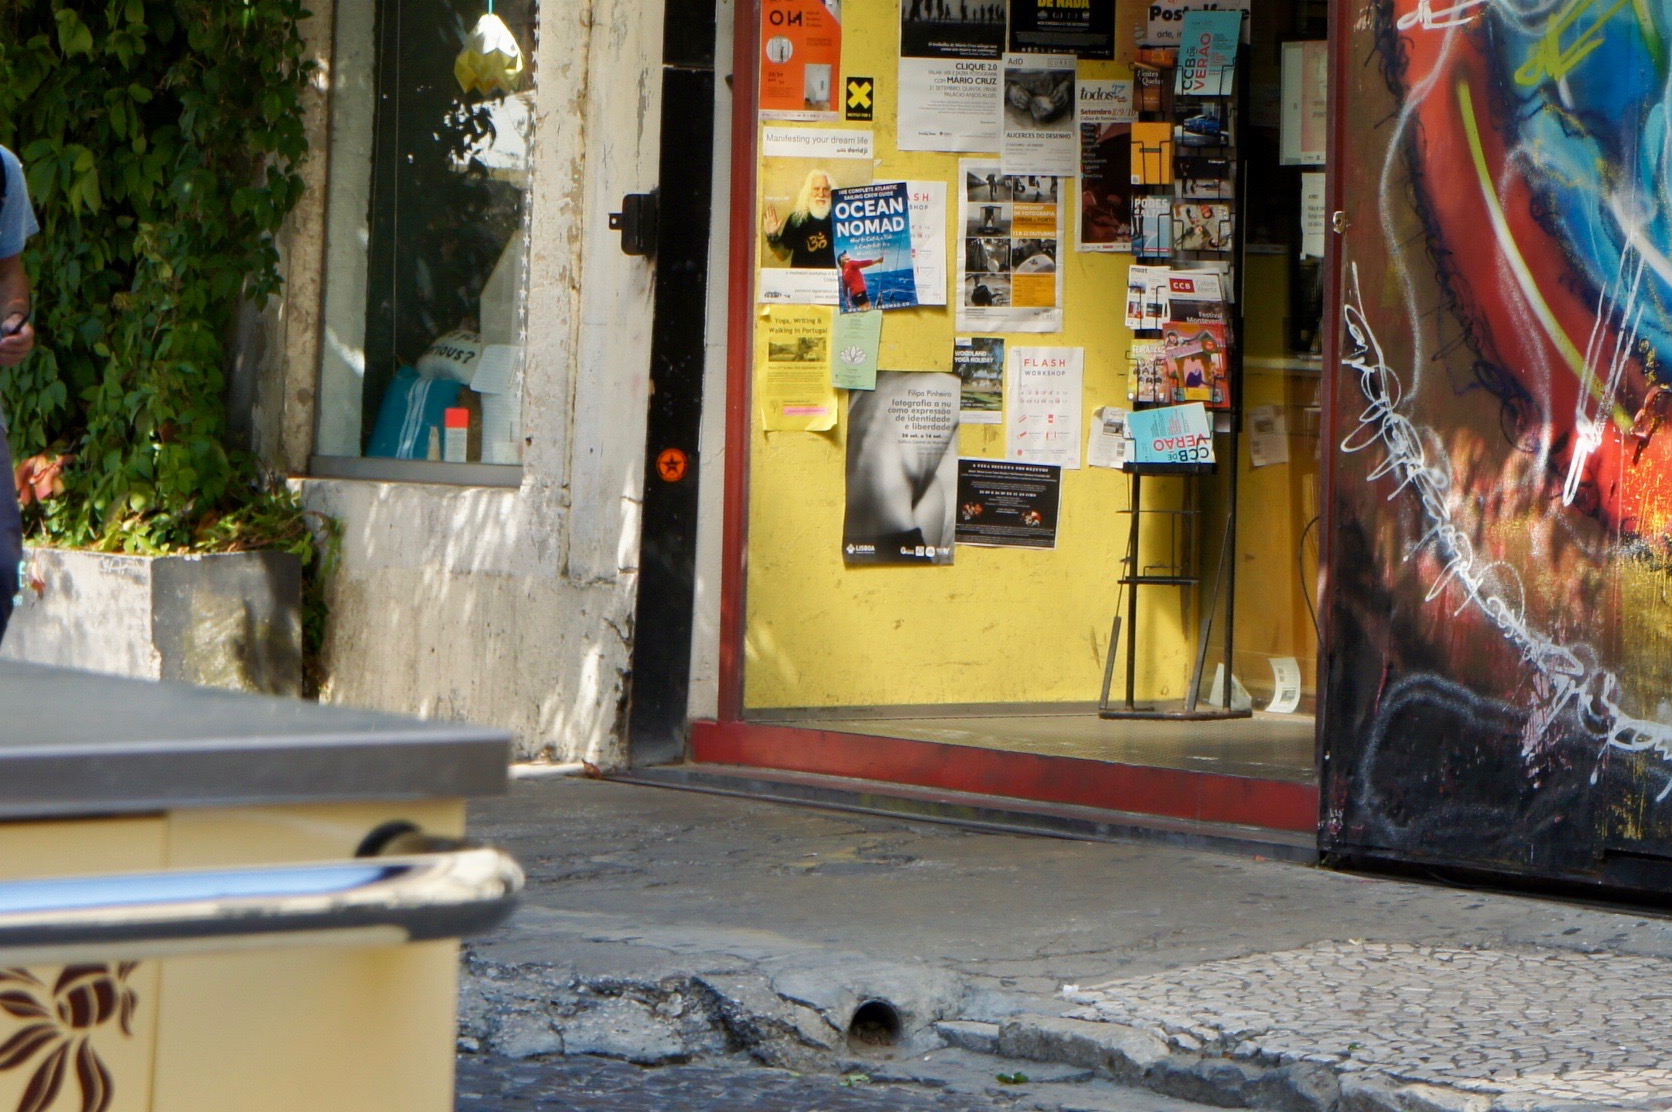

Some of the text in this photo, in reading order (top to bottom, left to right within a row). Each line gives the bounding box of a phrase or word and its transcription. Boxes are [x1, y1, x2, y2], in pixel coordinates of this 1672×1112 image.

[955, 62, 998, 71] CLIQUE 2.0
[946, 76, 974, 84] MÁRIO
[975, 77, 997, 85] CRUZ
[1080, 87, 1113, 101] todos
[766, 134, 868, 145] Manifesting your dream life
[849, 186, 874, 194] COMPLETE
[874, 184, 898, 192] ATLANTIC
[1134, 198, 1168, 208] PODES
[835, 197, 904, 219] OCEAN
[836, 216, 905, 238] NOMAD
[1172, 281, 1191, 290] CCB
[774, 317, 792, 325] Yoga,
[793, 317, 815, 325] Writing
[768, 327, 793, 335] Walking
[801, 327, 828, 335] Portugal
[1024, 358, 1066, 367] FLASH
[908, 390, 952, 398] Filipa Pinheiro
[891, 398, 932, 408] fotografia
[911, 407, 952, 416] expressão
[907, 415, 951, 423] identidade
[911, 423, 951, 431] liberdade
[1179, 447, 1210, 462] CCB
[855, 544, 875, 552] LISBOA
